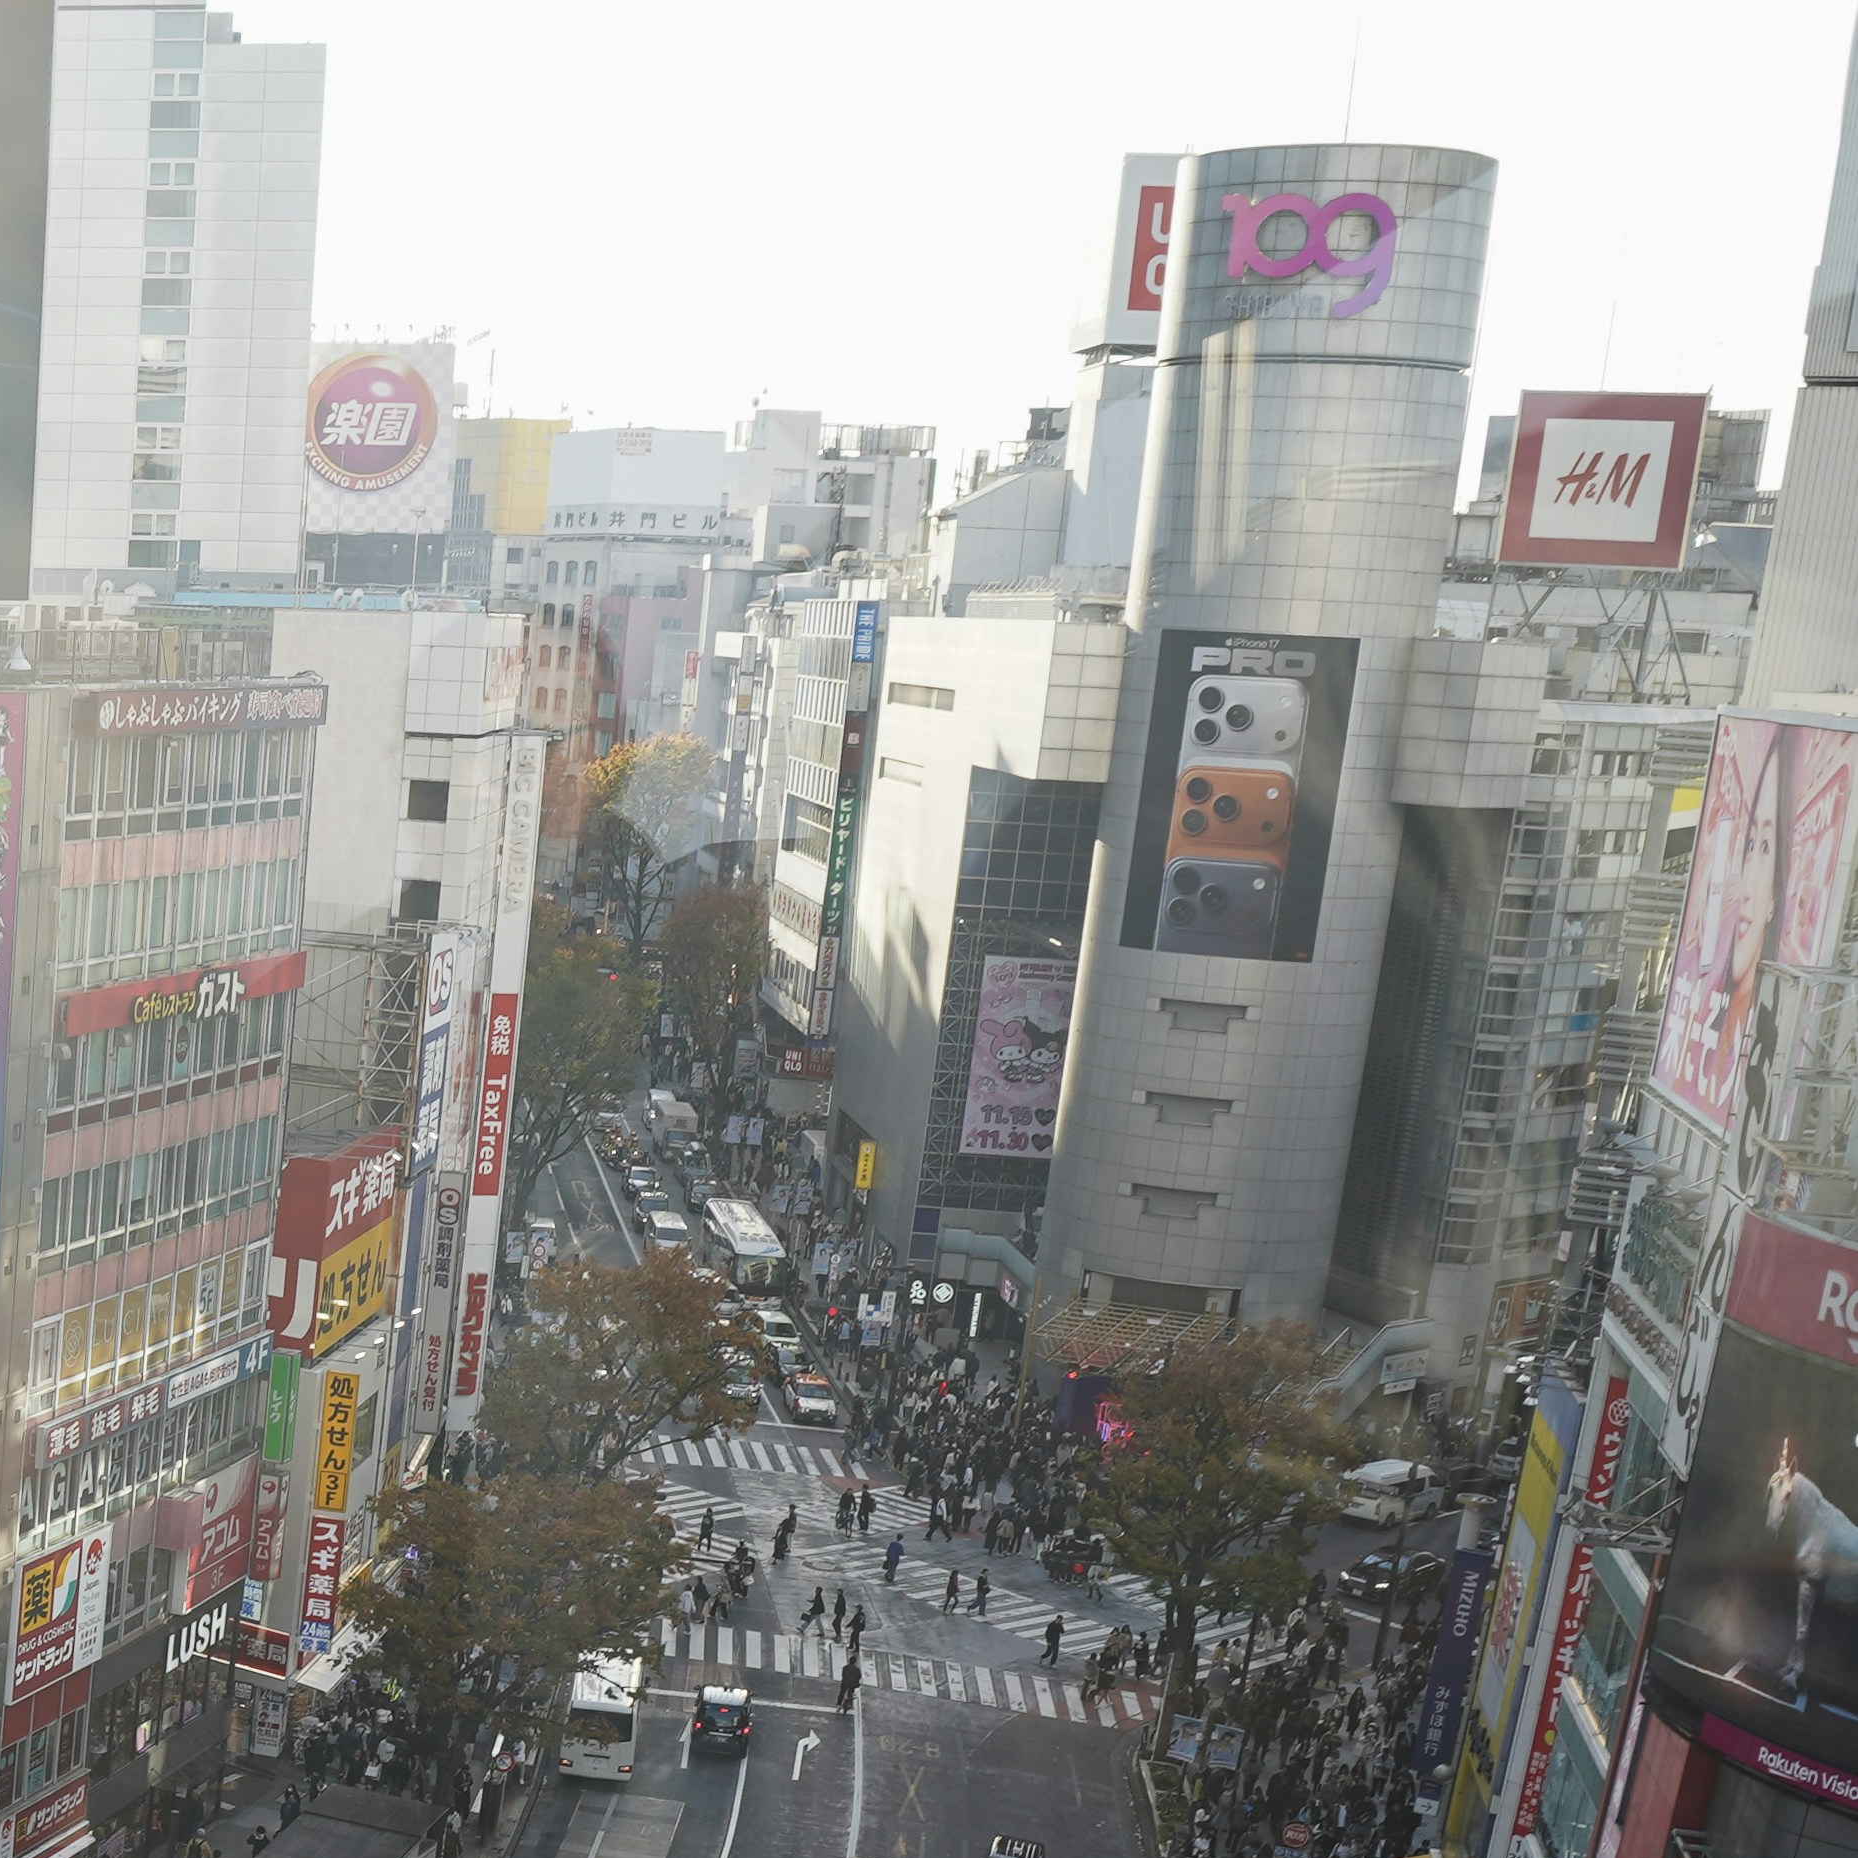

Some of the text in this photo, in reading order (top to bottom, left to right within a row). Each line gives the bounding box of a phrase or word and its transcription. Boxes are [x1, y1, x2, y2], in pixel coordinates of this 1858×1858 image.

[1222, 193, 1399, 320] 109
[1221, 294, 1325, 319] SHIBUYA
[320, 399, 419, 447] 楽園
[305, 441, 429, 491] EXCITING AMUSEMENT
[1554, 450, 1652, 509] H&M
[608, 510, 719, 531] 井門ビル
[1190, 645, 1317, 678] PRO
[114, 692, 244, 726] しゃぶしゃぶバイキング
[503, 799, 532, 914] CAMERA
[827, 797, 854, 925] ビリヤード・ダーツ
[196, 970, 246, 1021] ガスト
[429, 951, 454, 1008] OS
[491, 1014, 512, 1056] 免税
[785, 1050, 803, 1061] UNI
[784, 1062, 803, 1073] QLO
[478, 1074, 507, 1177] TaxFree
[980, 1103, 1034, 1126] 11.15
[976, 1128, 1030, 1151] 11.30
[325, 1148, 396, 1239] スギ薬局
[439, 1188, 461, 1225] OS
[199, 1288, 215, 1316] 5F
[317, 1250, 386, 1345] 処方せん
[244, 1336, 270, 1372] 4F
[455, 1271, 489, 1397] ビックカメラ
[423, 1333, 442, 1412] 処方せん受付
[49, 1386, 161, 1458] 薄毛 抜毛 発毛
[269, 1388, 282, 1425] レイク
[323, 1375, 354, 1471] 処方せん
[325, 1474, 340, 1506] 3F
[200, 1518, 241, 1565] アコム
[256, 1518, 270, 1560] アコム
[210, 1564, 225, 1590] 3F
[306, 1522, 340, 1621] スギ薬局
[22, 1569, 52, 1630] 薬
[1452, 1570, 1480, 1638] MIZUHO
[16, 1638, 37, 1657] DRUG
[165, 1602, 228, 1674] LUSH
[14, 1638, 74, 1687] サンドラッグ
[1423, 1685, 1451, 1757] みずほ銀行
[1758, 1744, 1818, 1787] Rakuten
[36, 1784, 86, 1828] サンドラッグ
